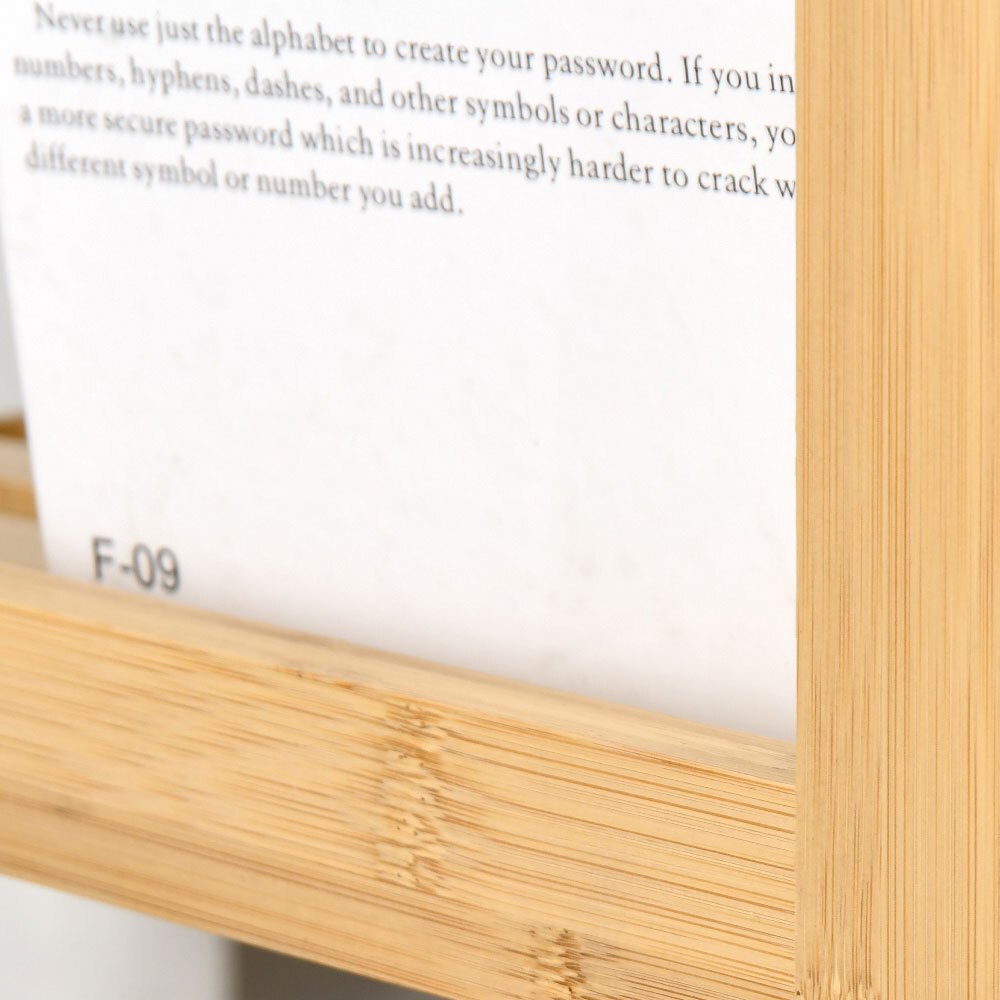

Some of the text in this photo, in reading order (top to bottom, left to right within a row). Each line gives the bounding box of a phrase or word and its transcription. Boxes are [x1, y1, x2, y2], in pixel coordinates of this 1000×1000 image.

[34, 2, 103, 34] Never
[112, 16, 148, 36] use
[156, 10, 198, 43] just
[207, 14, 243, 45] the
[252, 18, 354, 56] alphabet
[364, 33, 385, 57] to
[395, 34, 469, 65] create
[476, 46, 534, 74] your
[544, 51, 673, 83] password.
[682, 54, 702, 85] If
[710, 66, 760, 95] you
[14, 50, 125, 87] numbers,
[129, 56, 239, 98] hyphens,
[245, 67, 332, 107] dashes,
[340, 77, 383, 107] and
[392, 81, 458, 114] other
[466, 91, 570, 125] symbols
[577, 107, 603, 128] or
[612, 101, 758, 147] characters,
[20, 105, 31, 125] a
[38, 107, 98, 129] more
[104, 110, 177, 136] secure
[184, 119, 292, 147] password
[301, 122, 373, 156] which
[381, 130, 400, 157] is
[407, 133, 560, 181] increasingly
[568, 147, 653, 184] harder
[663, 164, 688, 188] to
[698, 164, 768, 197] crack
[25, 141, 463, 215] different symbol or number you add.
[92, 536, 180, 593] F-09
